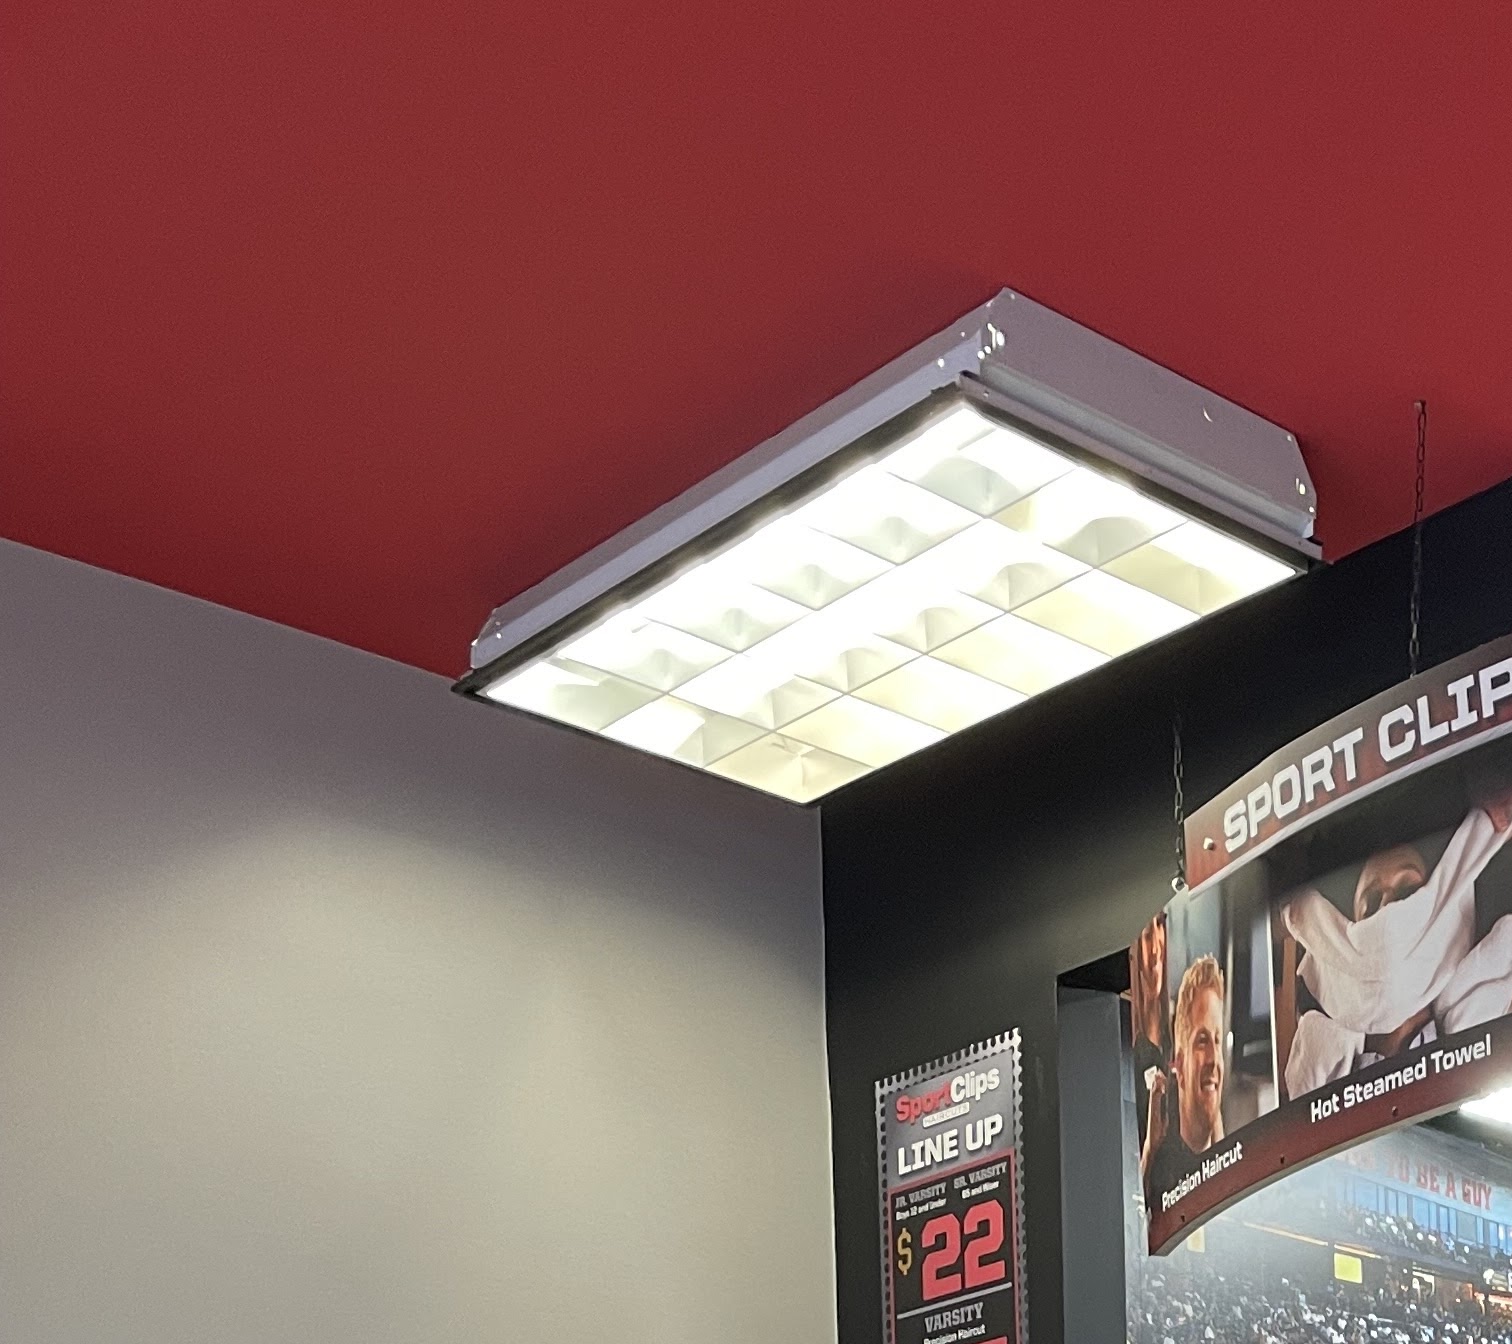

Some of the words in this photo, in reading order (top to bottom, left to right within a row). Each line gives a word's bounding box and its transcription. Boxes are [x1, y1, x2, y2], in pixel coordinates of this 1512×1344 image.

[1224, 727, 1363, 853] SPORT
[896, 1067, 1000, 1124] SportClips
[1310, 1099, 1340, 1123] Hot
[1343, 1055, 1427, 1108] Steamed
[1430, 1033, 1492, 1073] Towel
[897, 1128, 959, 1175] LINE
[965, 1113, 1003, 1152] UP
[968, 1161, 1007, 1184] VARSITY
[908, 1181, 947, 1204] VARSITY
[1161, 1168, 1201, 1212] Precision
[1200, 1140, 1244, 1184] Haircut
[1416, 1160, 1441, 1193] BE
[1445, 1169, 1457, 1200] A
[1461, 1178, 1493, 1210] GUY
[897, 1199, 1006, 1301] $22
[924, 1303, 984, 1333] VARSITY
